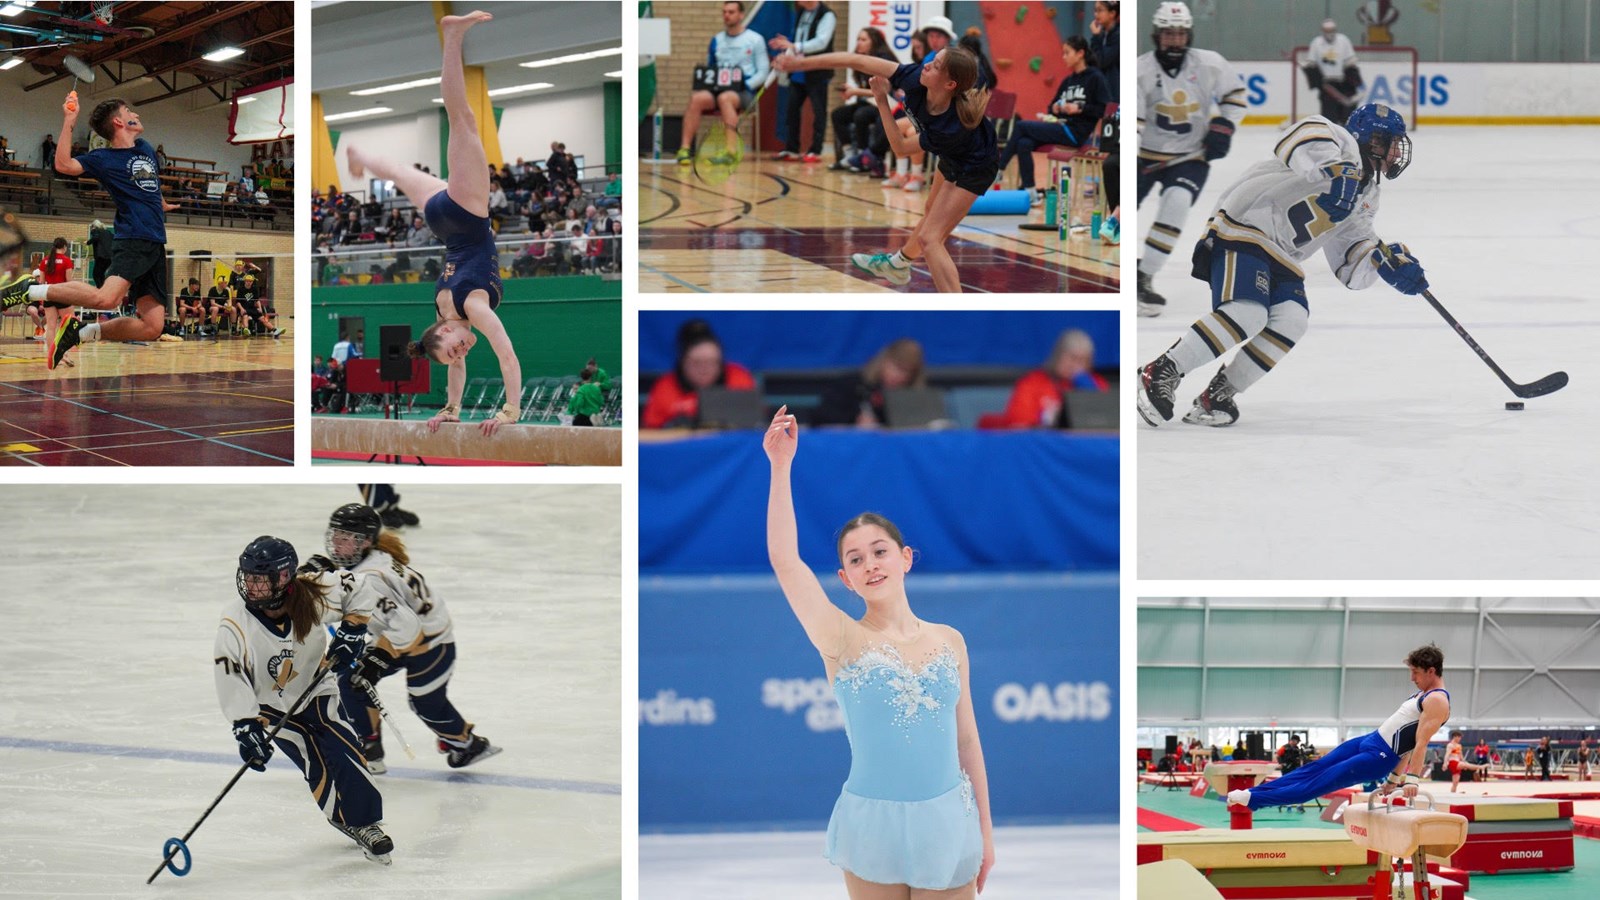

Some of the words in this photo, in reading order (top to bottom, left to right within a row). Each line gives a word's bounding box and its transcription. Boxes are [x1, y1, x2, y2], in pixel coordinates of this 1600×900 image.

[1359, 74, 1449, 107] ASIS
[762, 677, 836, 714] spo
[992, 681, 1112, 722] OASIS
